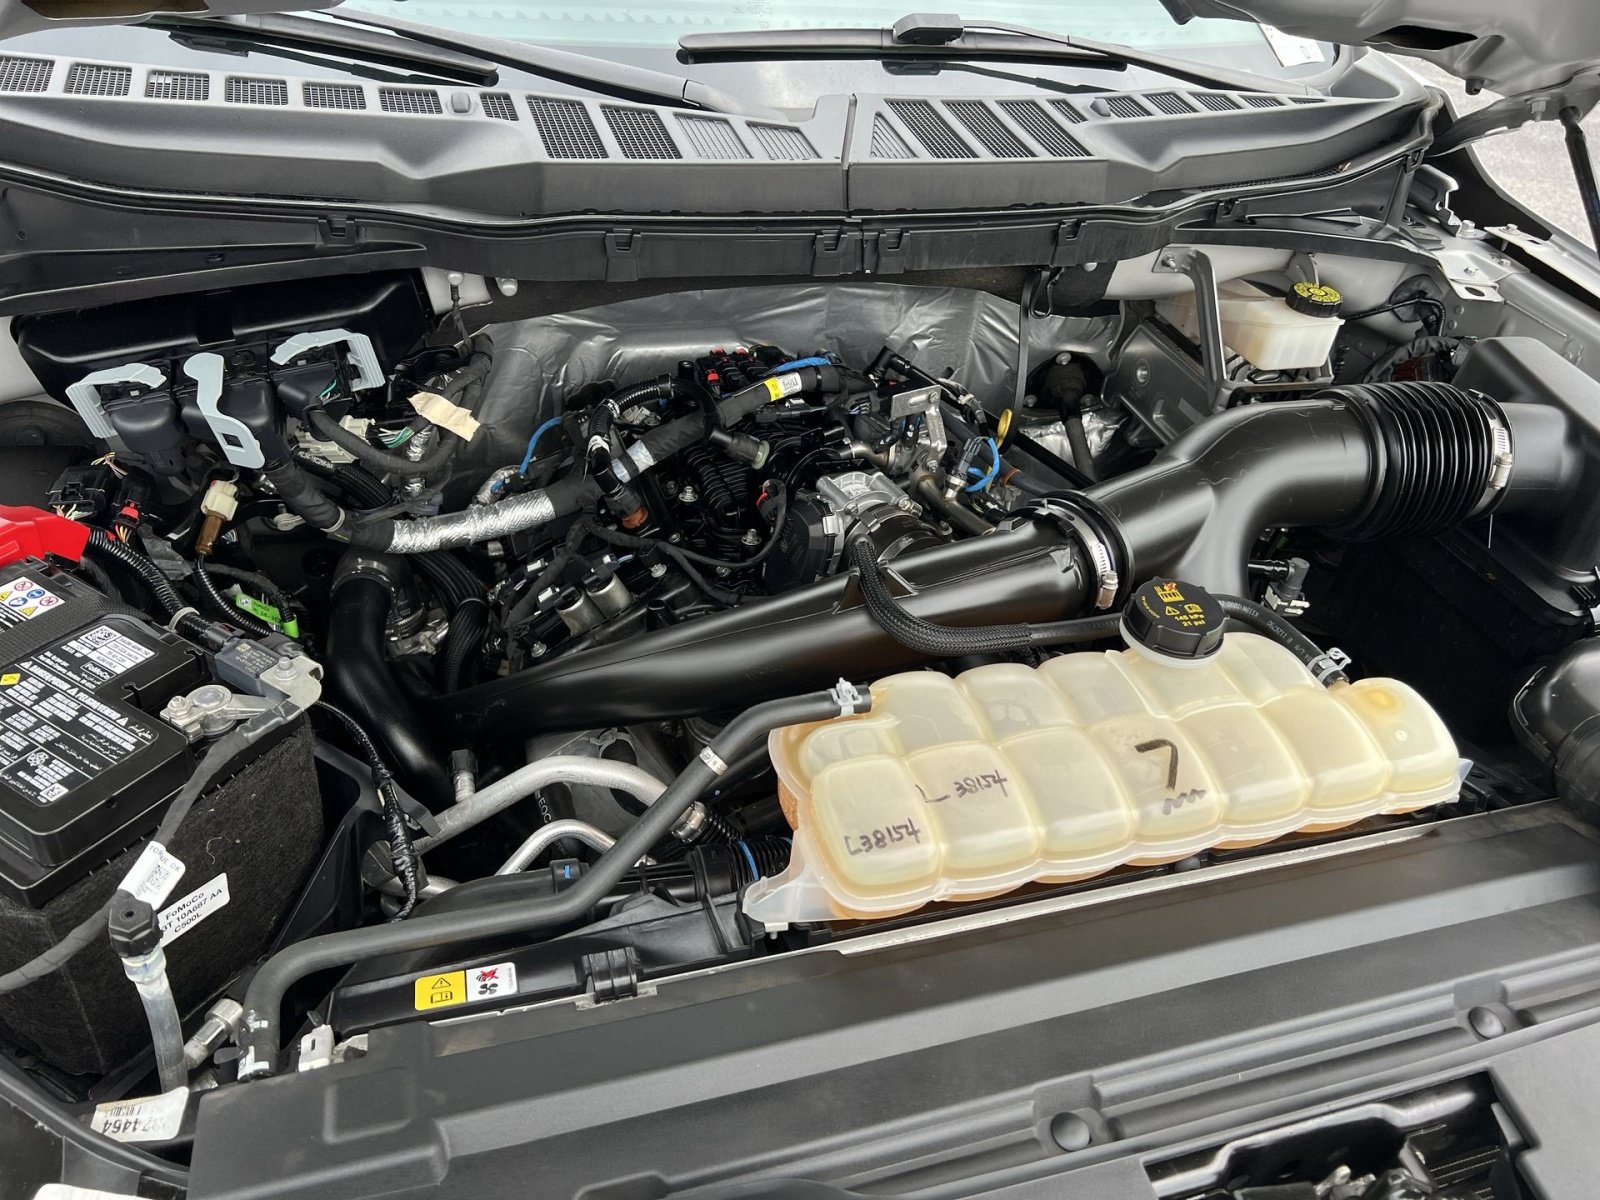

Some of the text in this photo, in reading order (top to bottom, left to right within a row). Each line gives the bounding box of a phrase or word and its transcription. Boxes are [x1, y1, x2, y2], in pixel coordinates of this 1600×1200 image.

[84, 662, 111, 680] FoMoCo
[1134, 737, 1179, 791] 7
[953, 769, 1008, 798] 38154
[844, 817, 921, 856] L38154
[149, 845, 182, 872] TORUE OK
[165, 892, 204, 920] FoMoCo
[176, 897, 208, 922] 10A687
[210, 888, 223, 901] AA
[174, 912, 203, 933] C500L
